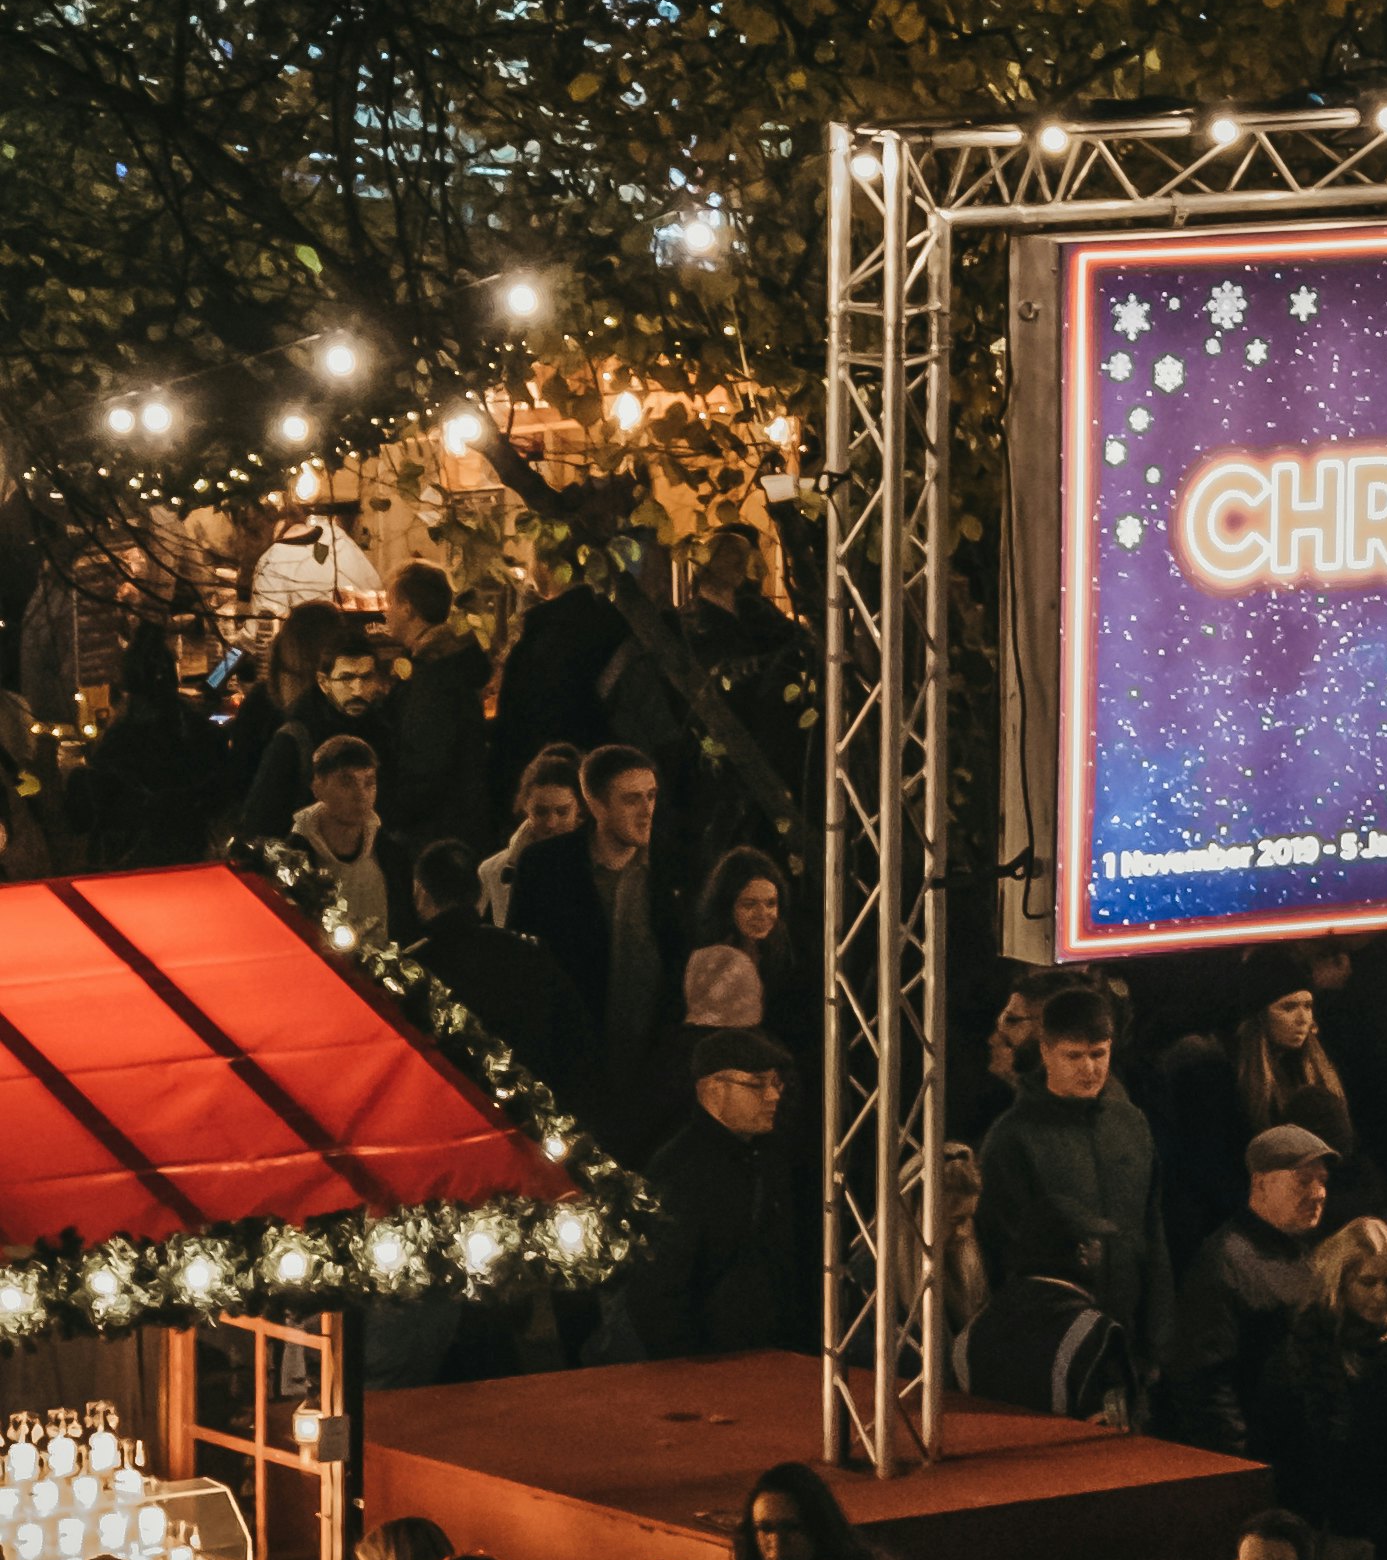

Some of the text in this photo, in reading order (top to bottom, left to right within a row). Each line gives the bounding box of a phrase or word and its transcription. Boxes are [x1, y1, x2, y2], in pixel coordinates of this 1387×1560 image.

[1119, 842, 1255, 879] November
[1255, 835, 1320, 868] 2019
[1339, 832, 1360, 861] 5
